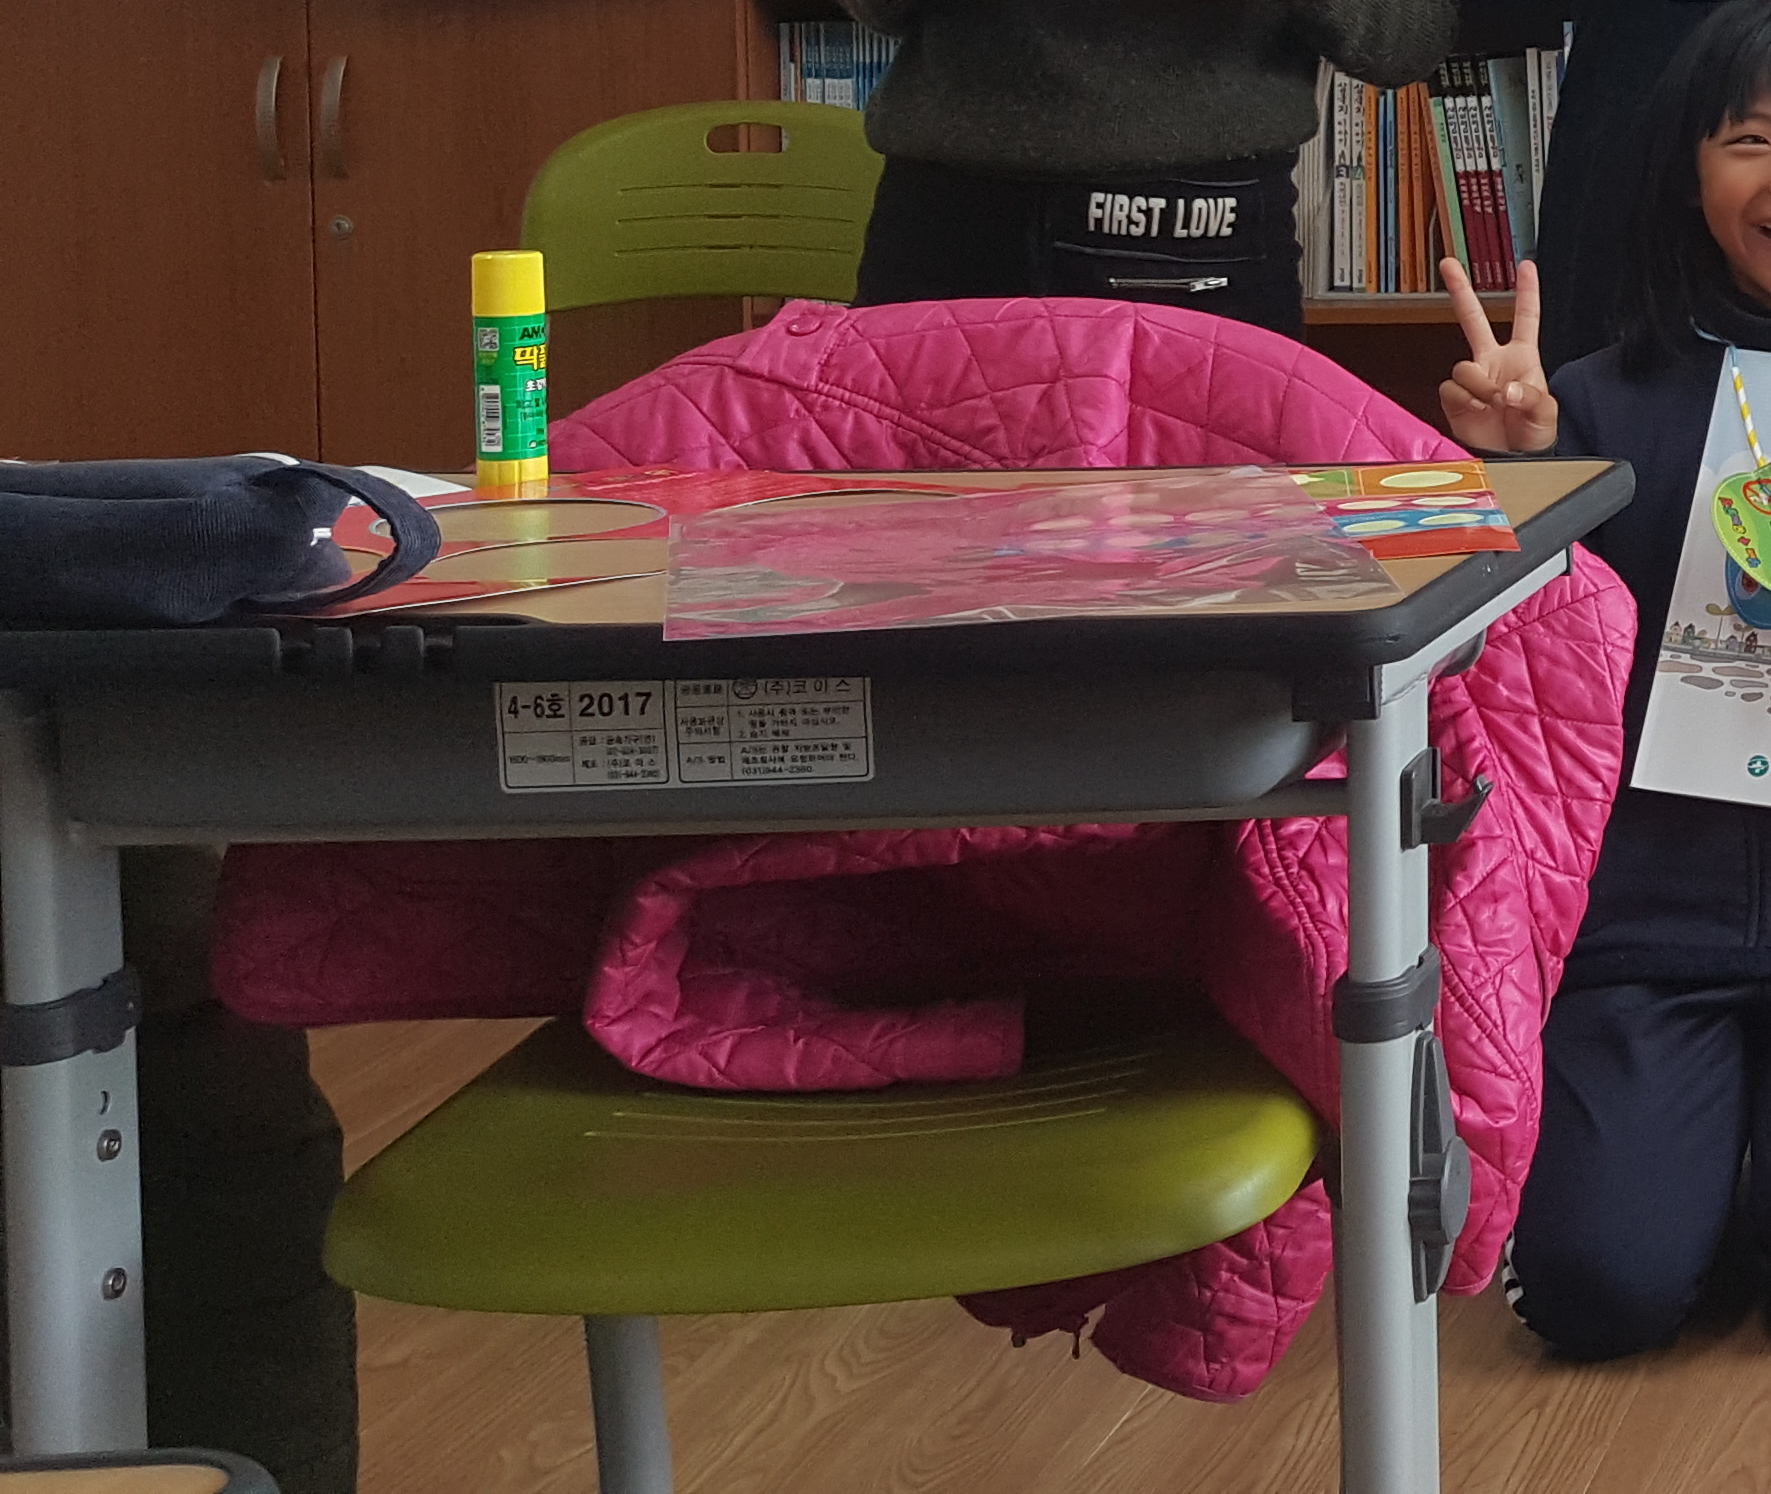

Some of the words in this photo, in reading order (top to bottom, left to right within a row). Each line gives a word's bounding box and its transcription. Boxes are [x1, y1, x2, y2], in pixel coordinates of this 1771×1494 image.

[1089, 191, 1167, 239] FIRST
[1174, 193, 1237, 239] LOVE
[507, 693, 566, 719] 4-6호
[579, 692, 652, 718] 2017
